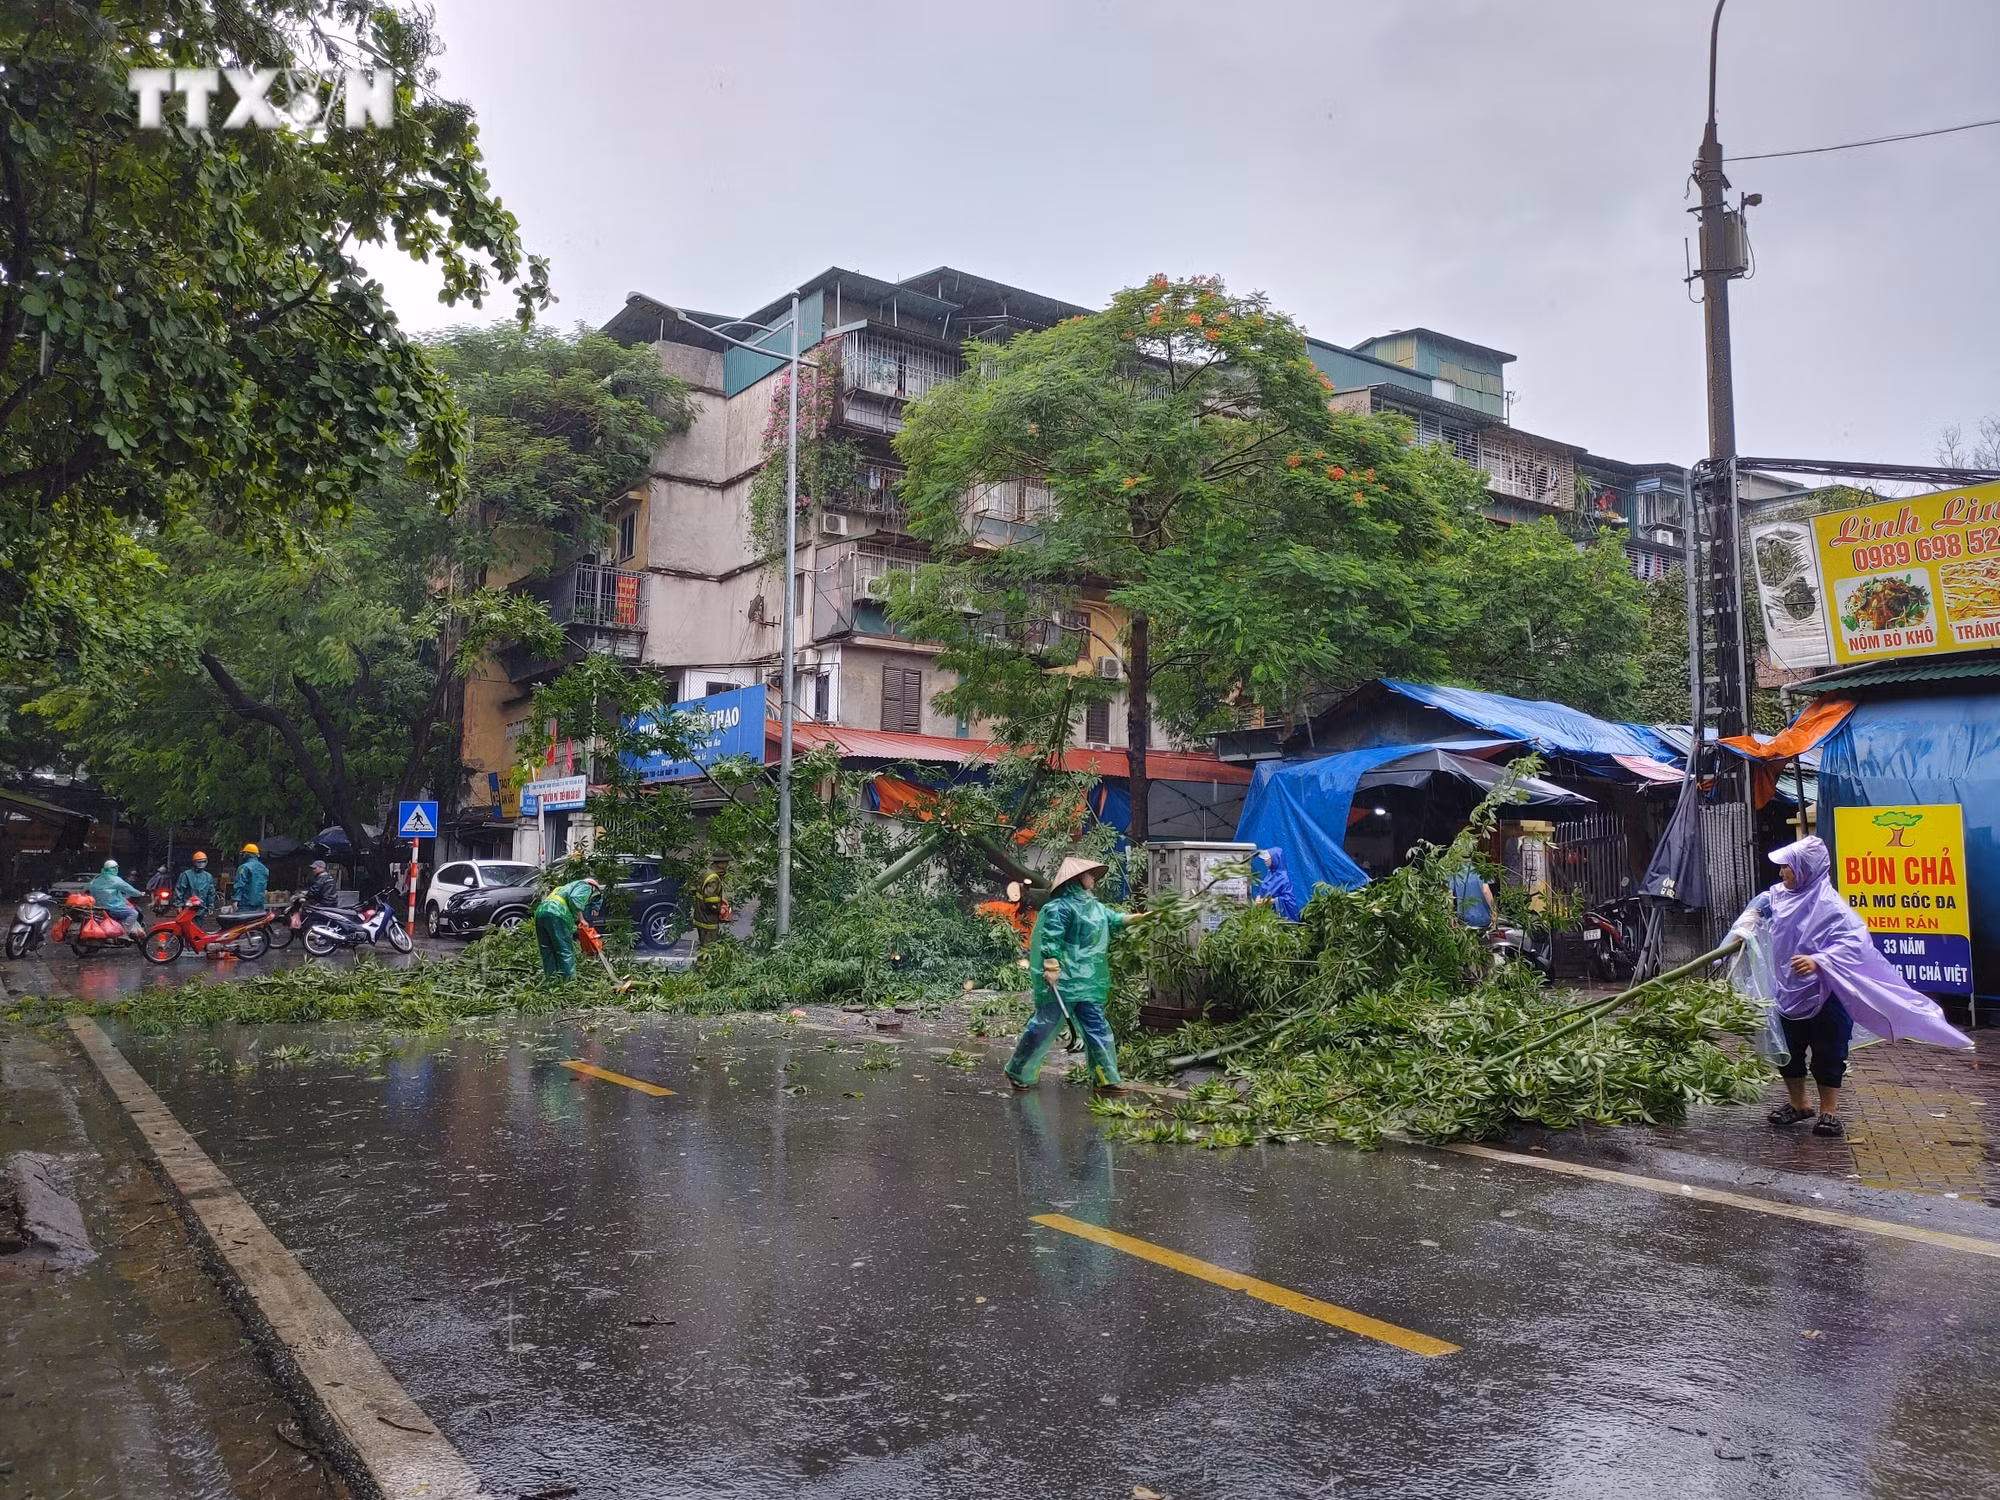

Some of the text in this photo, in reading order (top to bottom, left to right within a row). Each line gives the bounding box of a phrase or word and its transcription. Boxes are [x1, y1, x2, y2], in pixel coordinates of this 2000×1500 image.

[1830, 506, 1924, 547] Linh
[1852, 527, 2000, 573] 0989 698 52
[1849, 631, 1880, 653] NỘM
[1884, 630, 1902, 648] BÒ
[1906, 626, 1934, 645] KHÔ
[1846, 847, 1956, 885] BÚN CHẢ
[1849, 891, 1956, 909] BÀ MƠ GỐC ĐA
[1867, 915, 1939, 929] NEM RÁN
[1884, 936, 1925, 955] 33 NĂM
[1906, 966, 1917, 983] VỊ
[1920, 961, 1941, 982] CHẢ
[1944, 965, 1967, 985] VIỆT
